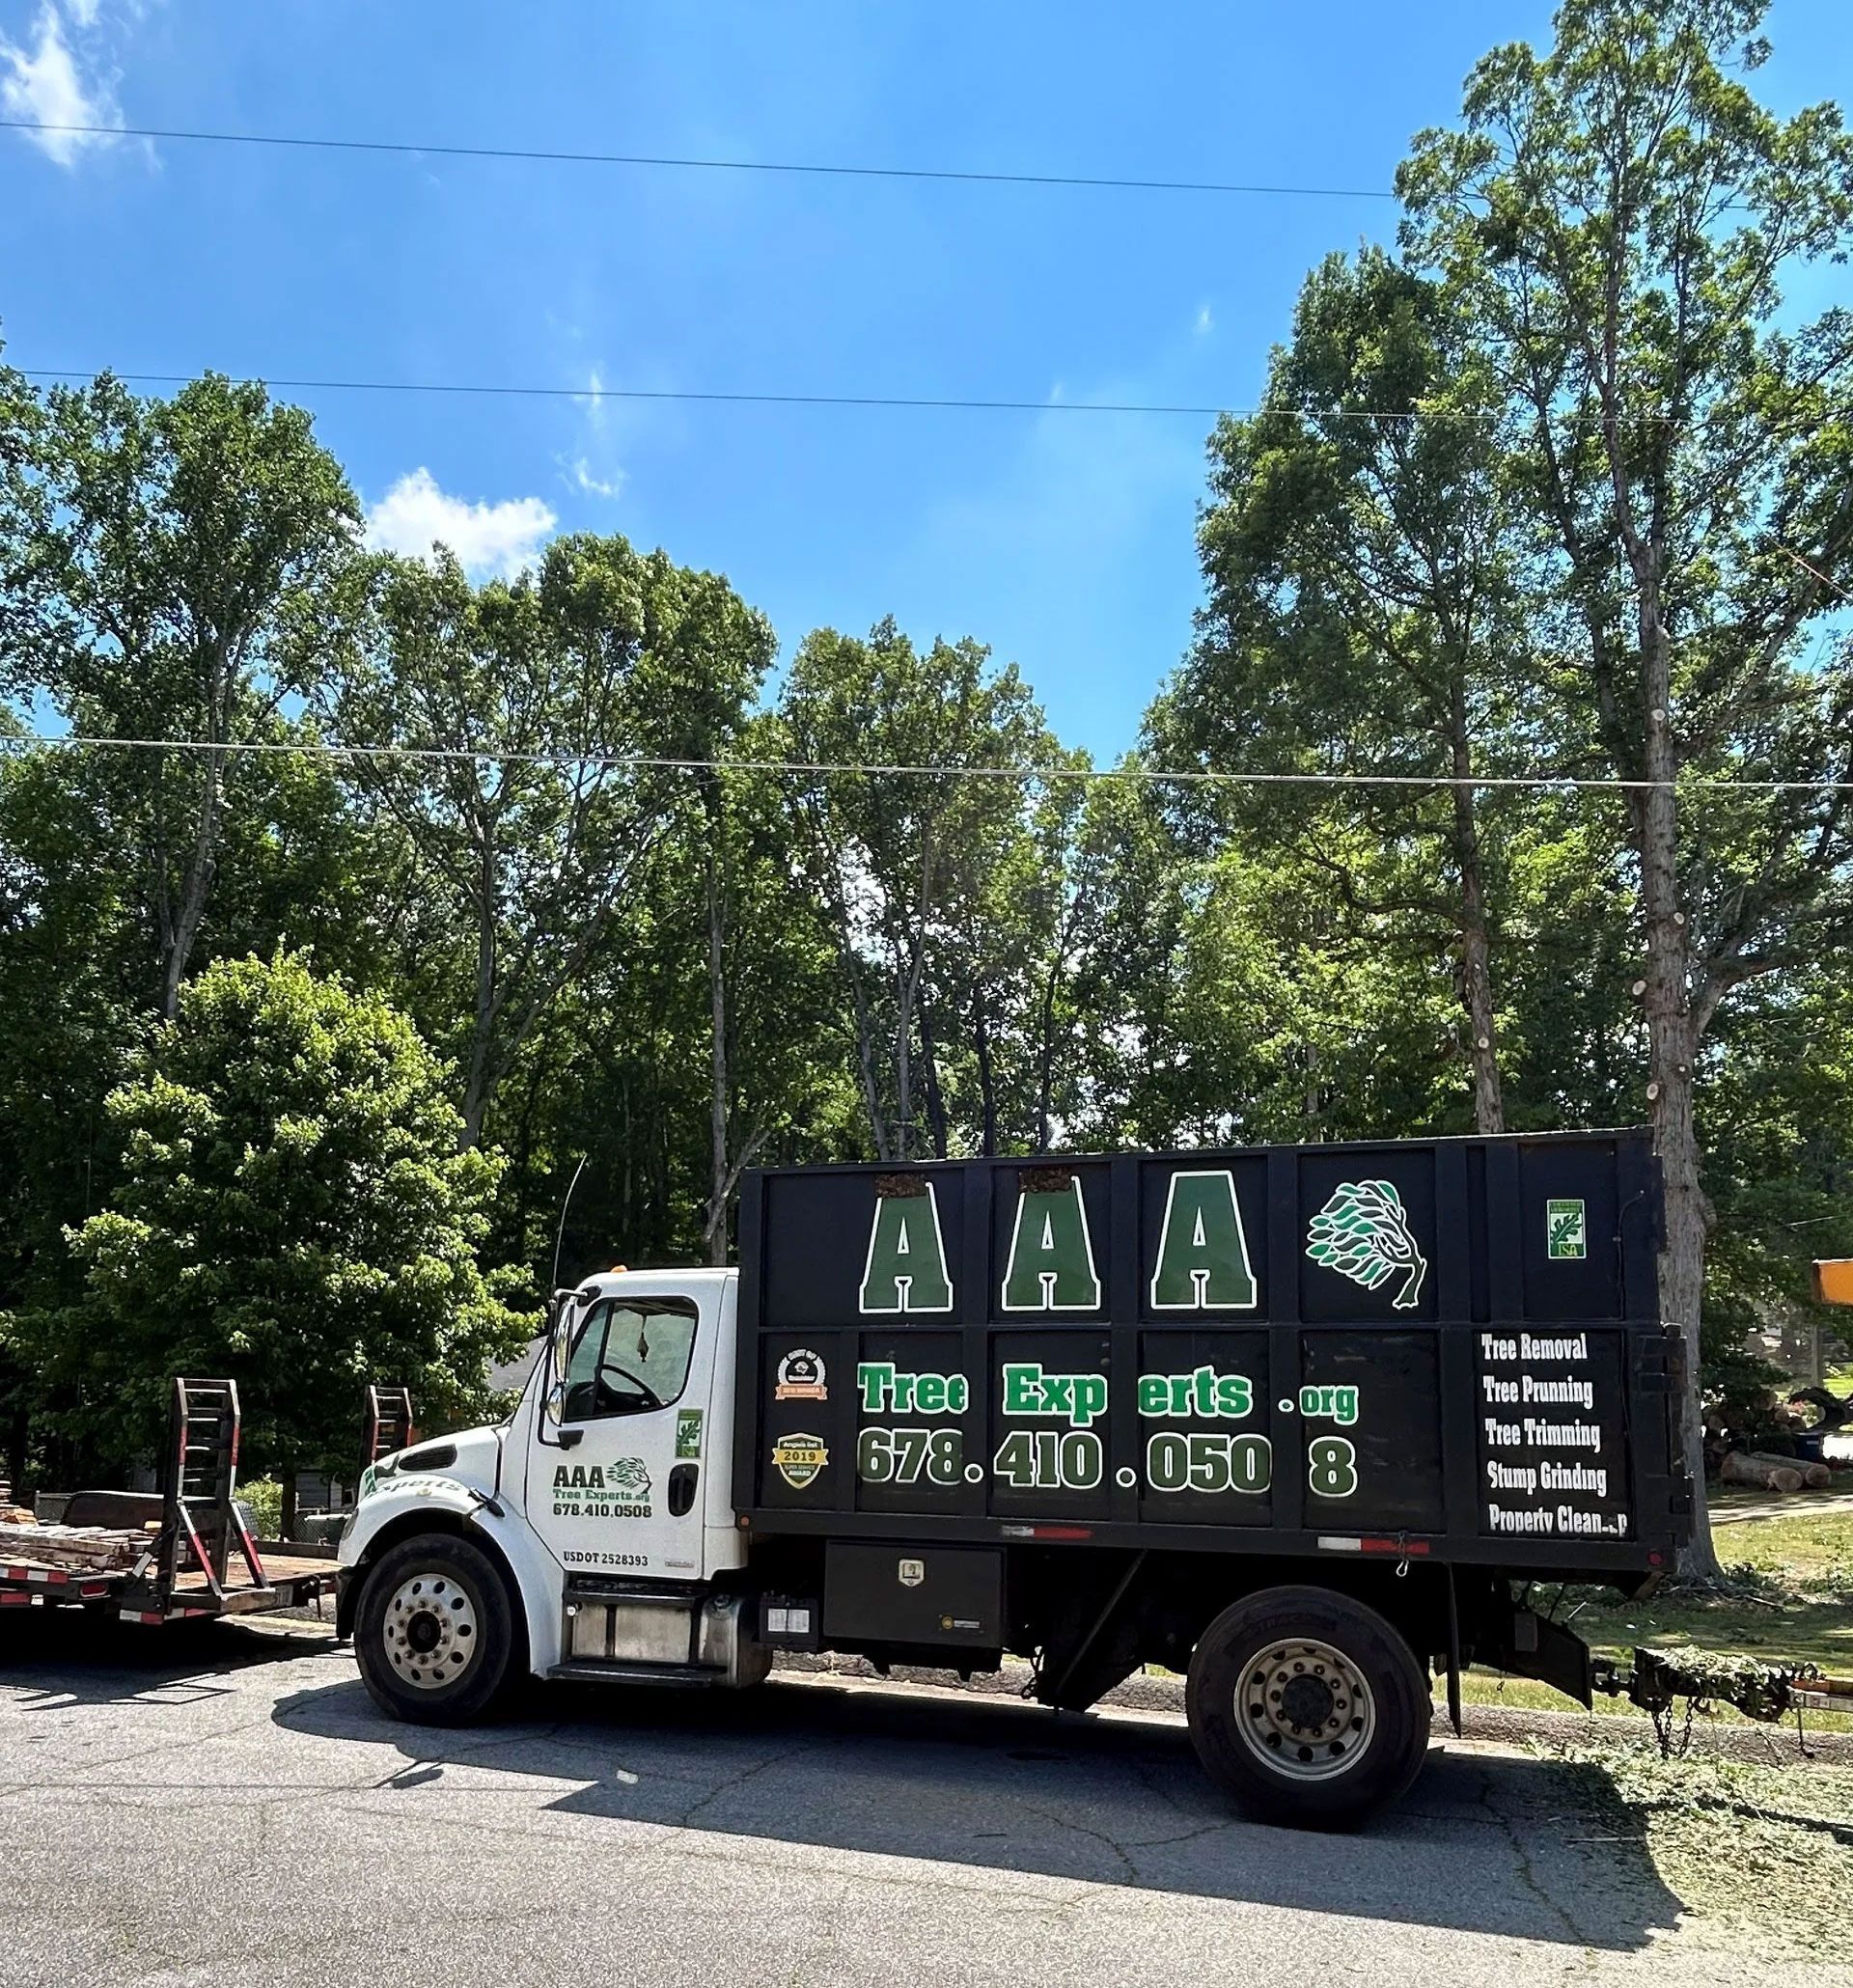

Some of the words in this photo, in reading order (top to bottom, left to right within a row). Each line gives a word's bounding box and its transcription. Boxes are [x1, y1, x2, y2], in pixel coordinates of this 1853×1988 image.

[1481, 1334, 1517, 1360] Tree
[1520, 1333, 1589, 1360] Removal
[857, 1363, 969, 1415] Tree
[1482, 1375, 1519, 1402] Tree
[1522, 1375, 1593, 1410] Prunning
[1484, 1418, 1521, 1446] Tree
[1524, 1419, 1601, 1453] Trimming
[784, 1451, 816, 1462] 2019
[553, 1465, 605, 1488] AAA
[1487, 1460, 1536, 1495] Stump
[1540, 1461, 1607, 1497] Grinding
[553, 1489, 582, 1500] Tree
[553, 1503, 652, 1518] 678.410.0508
[564, 1551, 599, 1562] USDOT
[601, 1553, 649, 1566] 2528393
